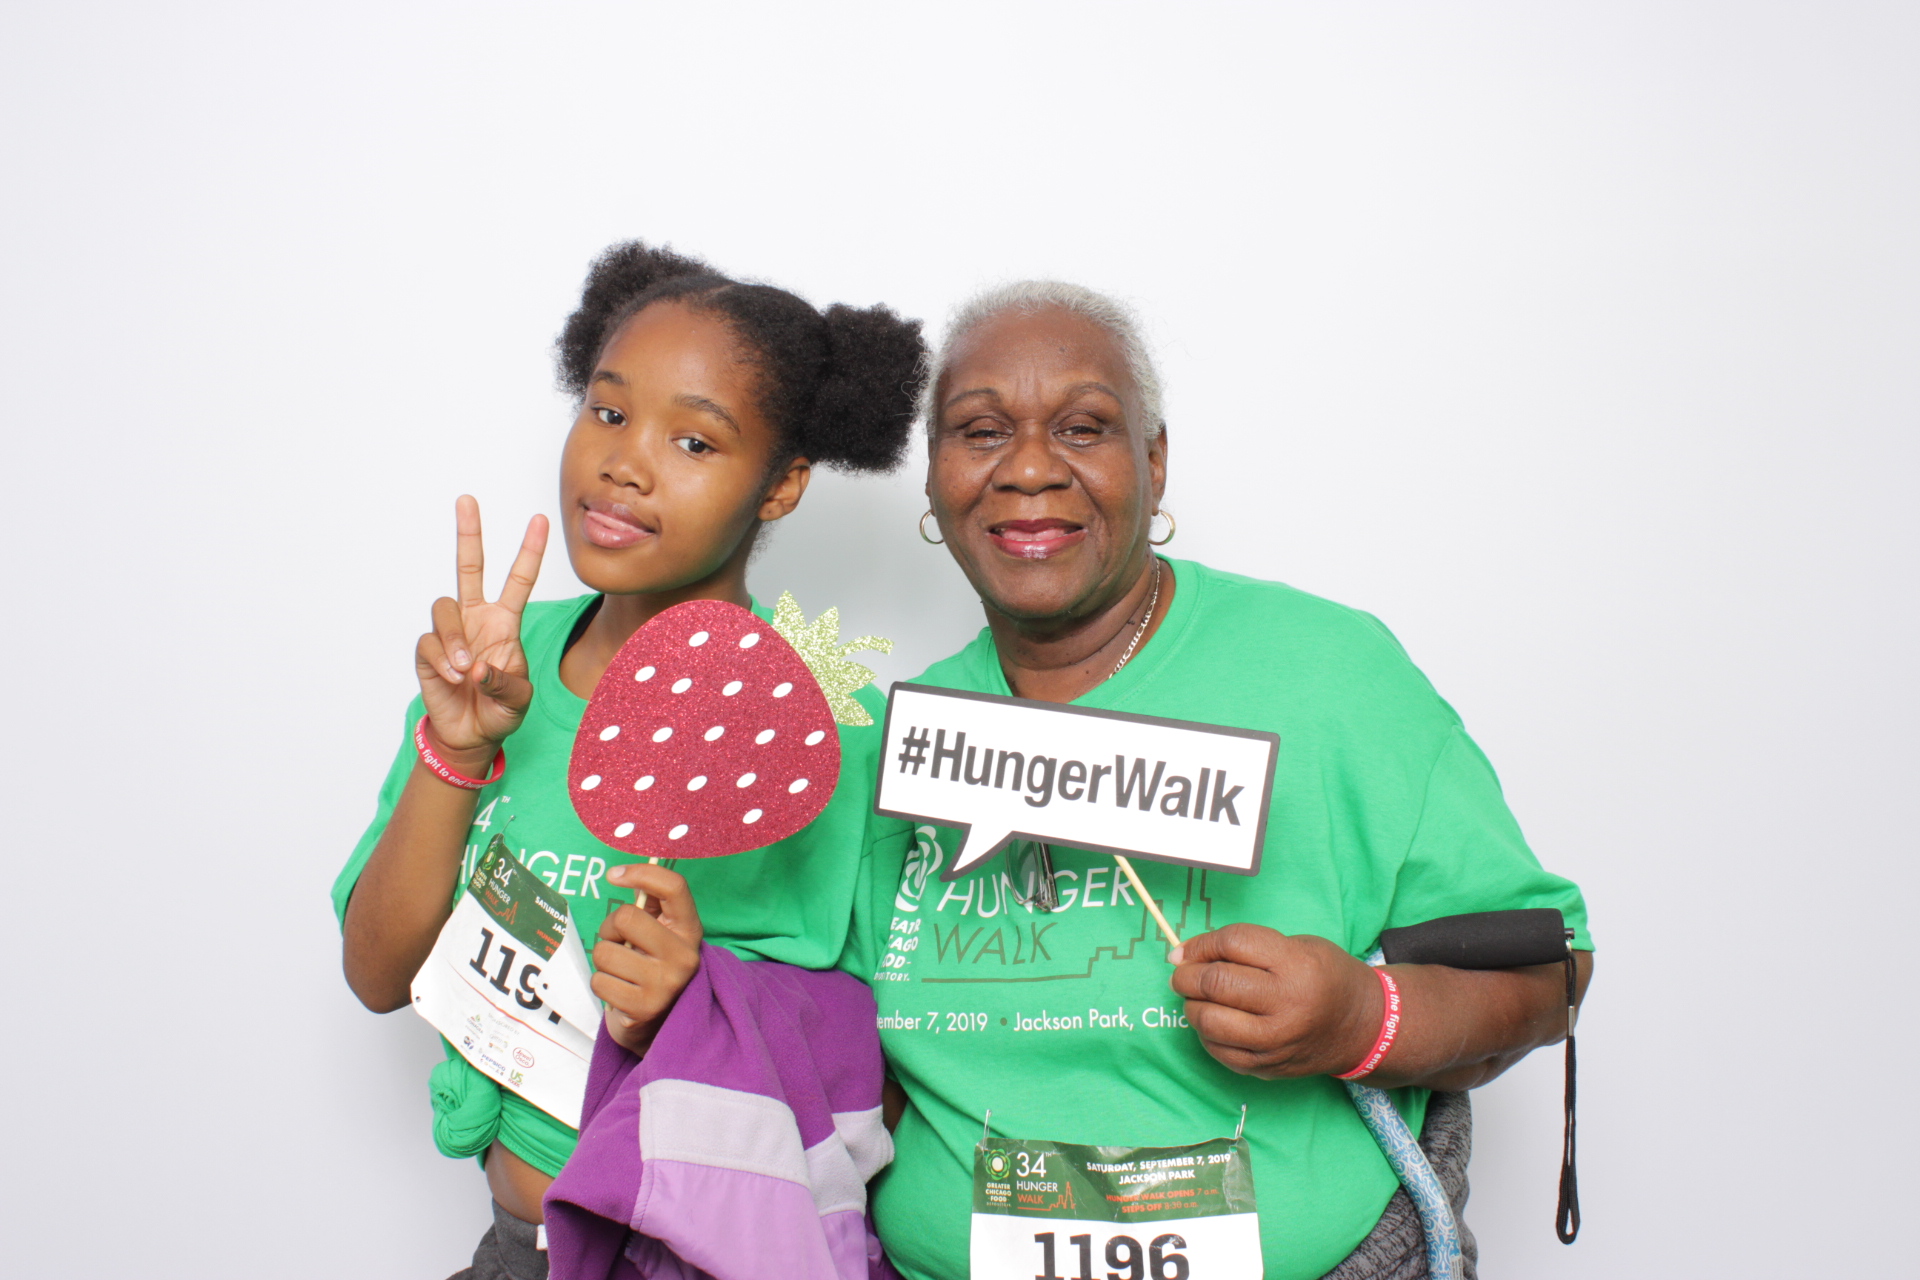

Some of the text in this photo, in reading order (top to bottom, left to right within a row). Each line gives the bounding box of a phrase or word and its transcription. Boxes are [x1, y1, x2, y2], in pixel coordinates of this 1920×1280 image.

[415, 733, 425, 750] the
[422, 749, 442, 770] fight
[438, 767, 449, 777] to
[448, 775, 467, 786] end
[898, 726, 1245, 826] #HungerWalk
[488, 877, 511, 905] HUNGER
[936, 866, 1136, 918] HUNGER
[933, 921, 1059, 965] WALK
[469, 927, 562, 1025] 119
[1382, 973, 1396, 992] Join
[1390, 994, 1400, 1011] the
[927, 1012, 940, 1034] 7,
[946, 1012, 988, 1031] 2019
[1014, 1010, 1083, 1032] Jackson
[1089, 1006, 1134, 1031] Park,
[1384, 1014, 1399, 1040] fight
[1378, 1041, 1391, 1052] to
[482, 1054, 506, 1072] PEPSICO
[1365, 1053, 1382, 1070] end
[1086, 1153, 1231, 1173] SATURDAY, SEPTEMBER 7, 2019
[986, 1182, 1011, 1190] GREATER
[1016, 1180, 1059, 1192] HUNGER
[1118, 1169, 1196, 1185] JACKSON PARK
[985, 1189, 1012, 1197] CHICAGO
[1017, 1194, 1044, 1204] WALK
[1105, 1194, 1139, 1203] HUNGER
[1140, 1192, 1166, 1201] WALK
[1166, 1189, 1195, 1199] OPENS
[1121, 1203, 1146, 1213] STEPS
[1146, 1202, 1162, 1211] OFF
[1164, 1201, 1182, 1209] 8:30
[1034, 1231, 1190, 1280] 1196
